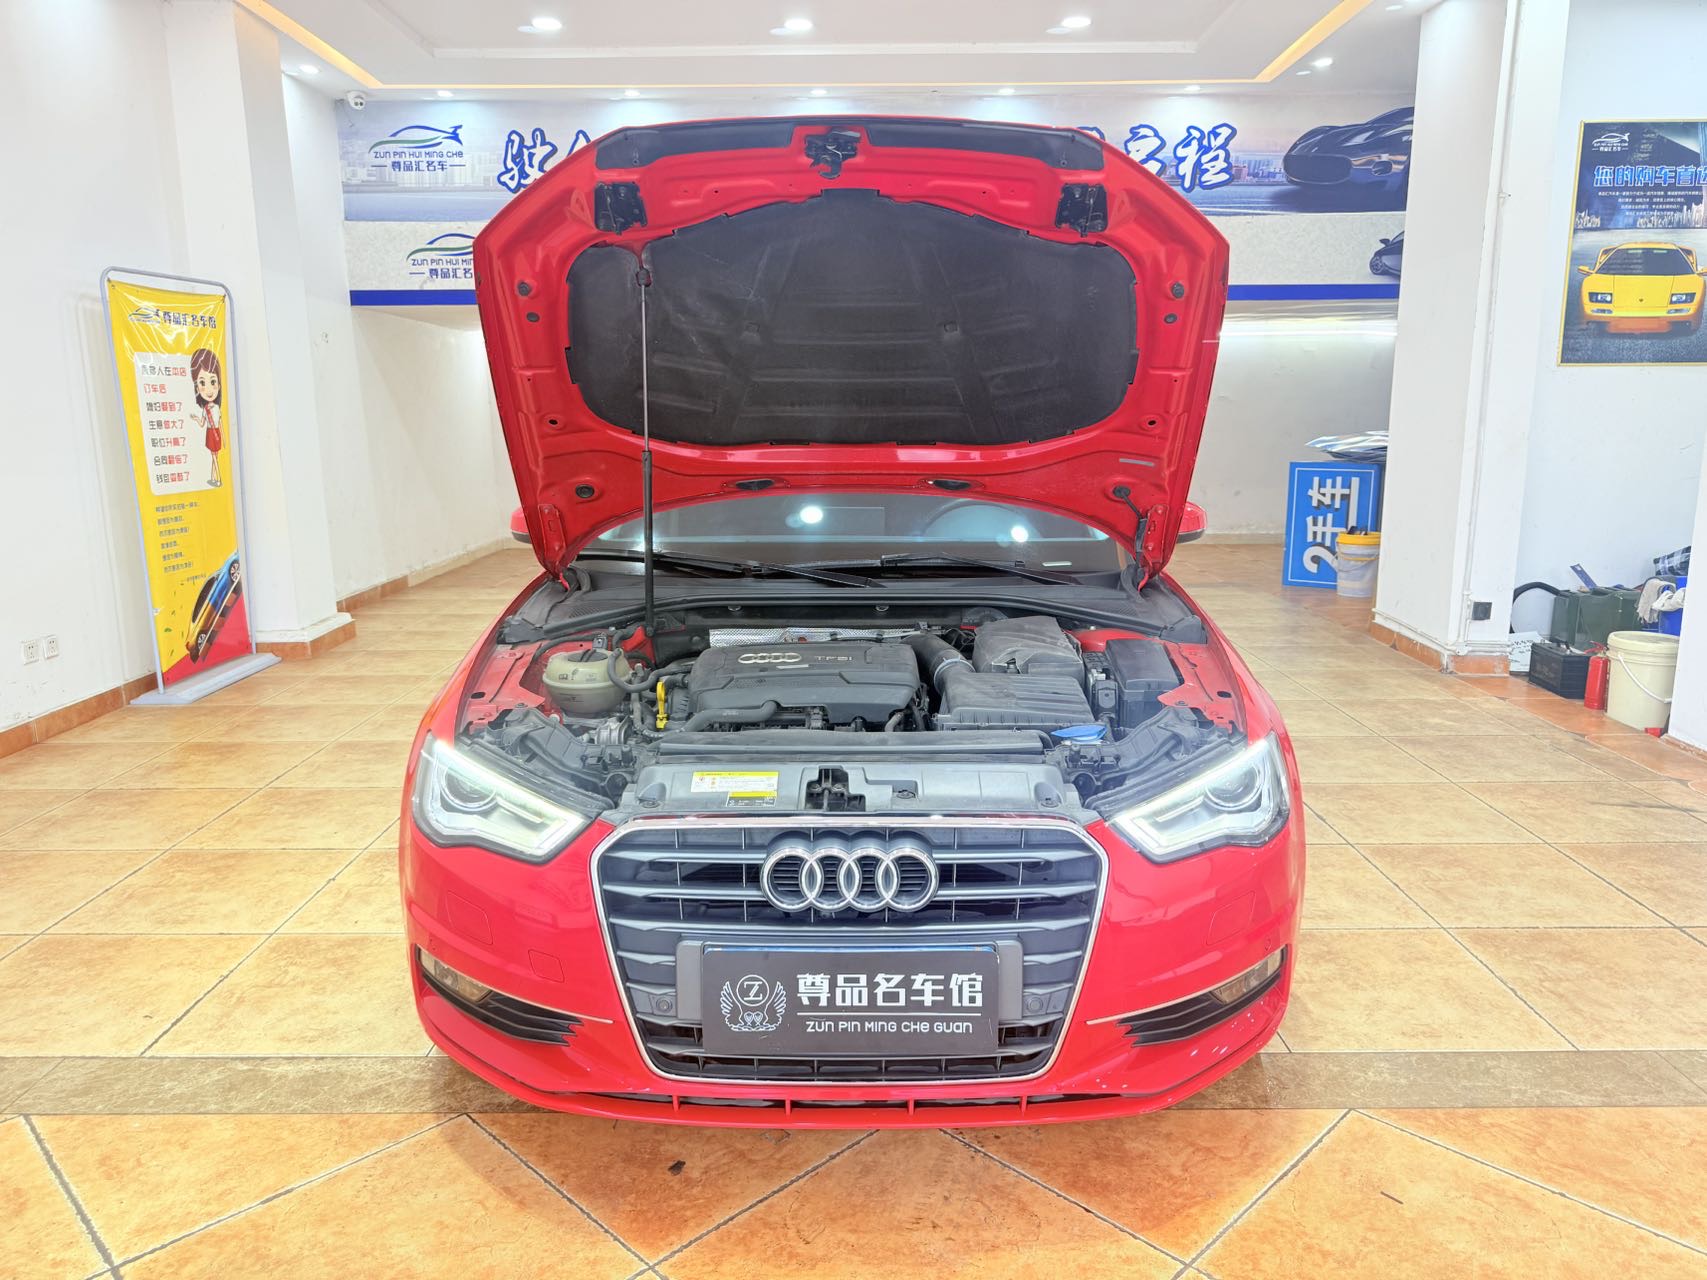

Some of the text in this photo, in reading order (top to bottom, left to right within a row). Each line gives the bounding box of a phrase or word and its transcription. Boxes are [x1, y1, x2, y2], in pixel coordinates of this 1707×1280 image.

[391, 160, 448, 172] 尊品汇名车
[497, 128, 592, 194] 驶
[796, 972, 983, 1007] 尊品名车馆
